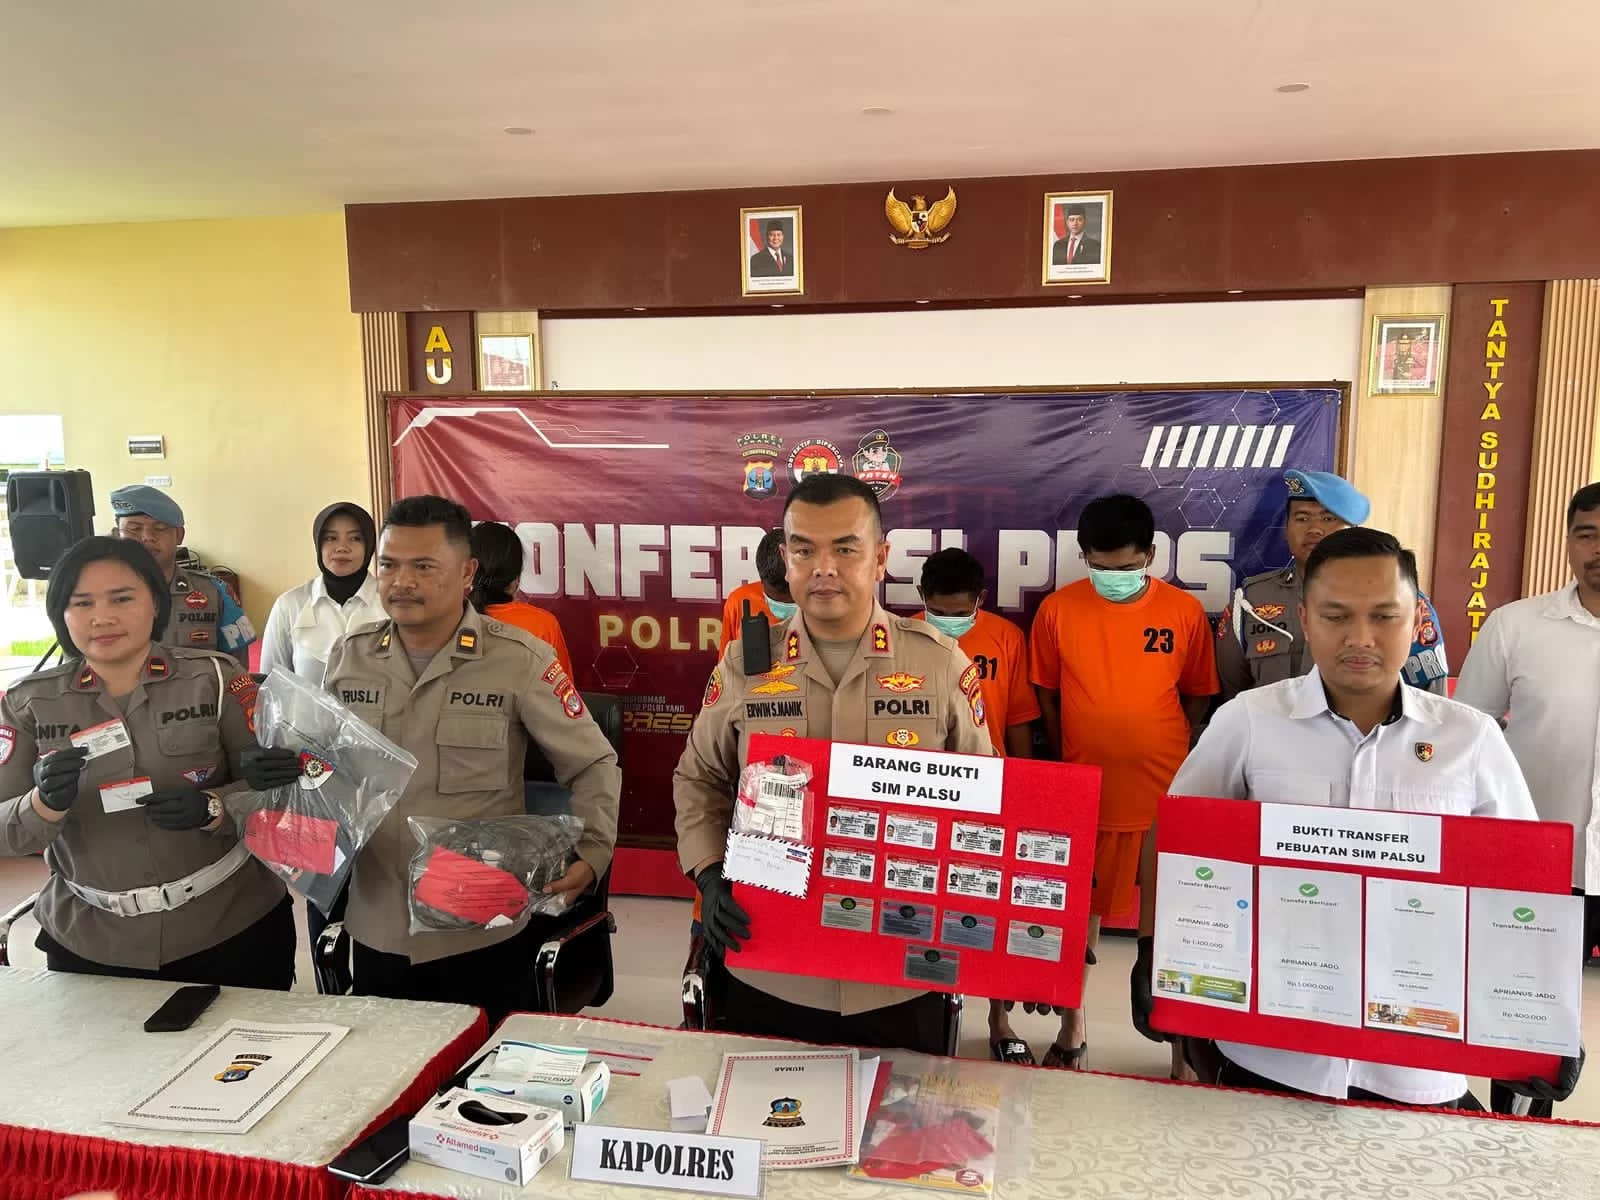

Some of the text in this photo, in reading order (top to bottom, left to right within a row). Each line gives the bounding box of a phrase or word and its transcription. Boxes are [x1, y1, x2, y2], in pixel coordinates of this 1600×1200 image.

[424, 326, 453, 385] AU
[1481, 299, 1509, 420] TANTYA
[787, 439, 845, 468] OBYEKTIF DIPERCAYA
[858, 471, 898, 481] PATEN
[178, 612, 217, 623] POLRI
[599, 615, 723, 652] POLR
[1143, 627, 1174, 654] 23
[974, 655, 998, 681] 31
[342, 690, 379, 704] RUSLI
[450, 692, 504, 708] POLRI
[161, 703, 218, 724] POLRI
[746, 702, 771, 718] ERWIN
[874, 700, 930, 716] POLRI
[624, 711, 696, 730] PRES
[853, 755, 979, 780] BARANG BUKTI
[871, 781, 961, 802] SIM PALSU
[1292, 825, 1409, 844] BUKTI TRANSFER
[1276, 841, 1425, 863] PEBUATAN SIM PALSU
[446, 1136, 479, 1152] Altamed
[599, 1138, 735, 1181] KAPOLRES
